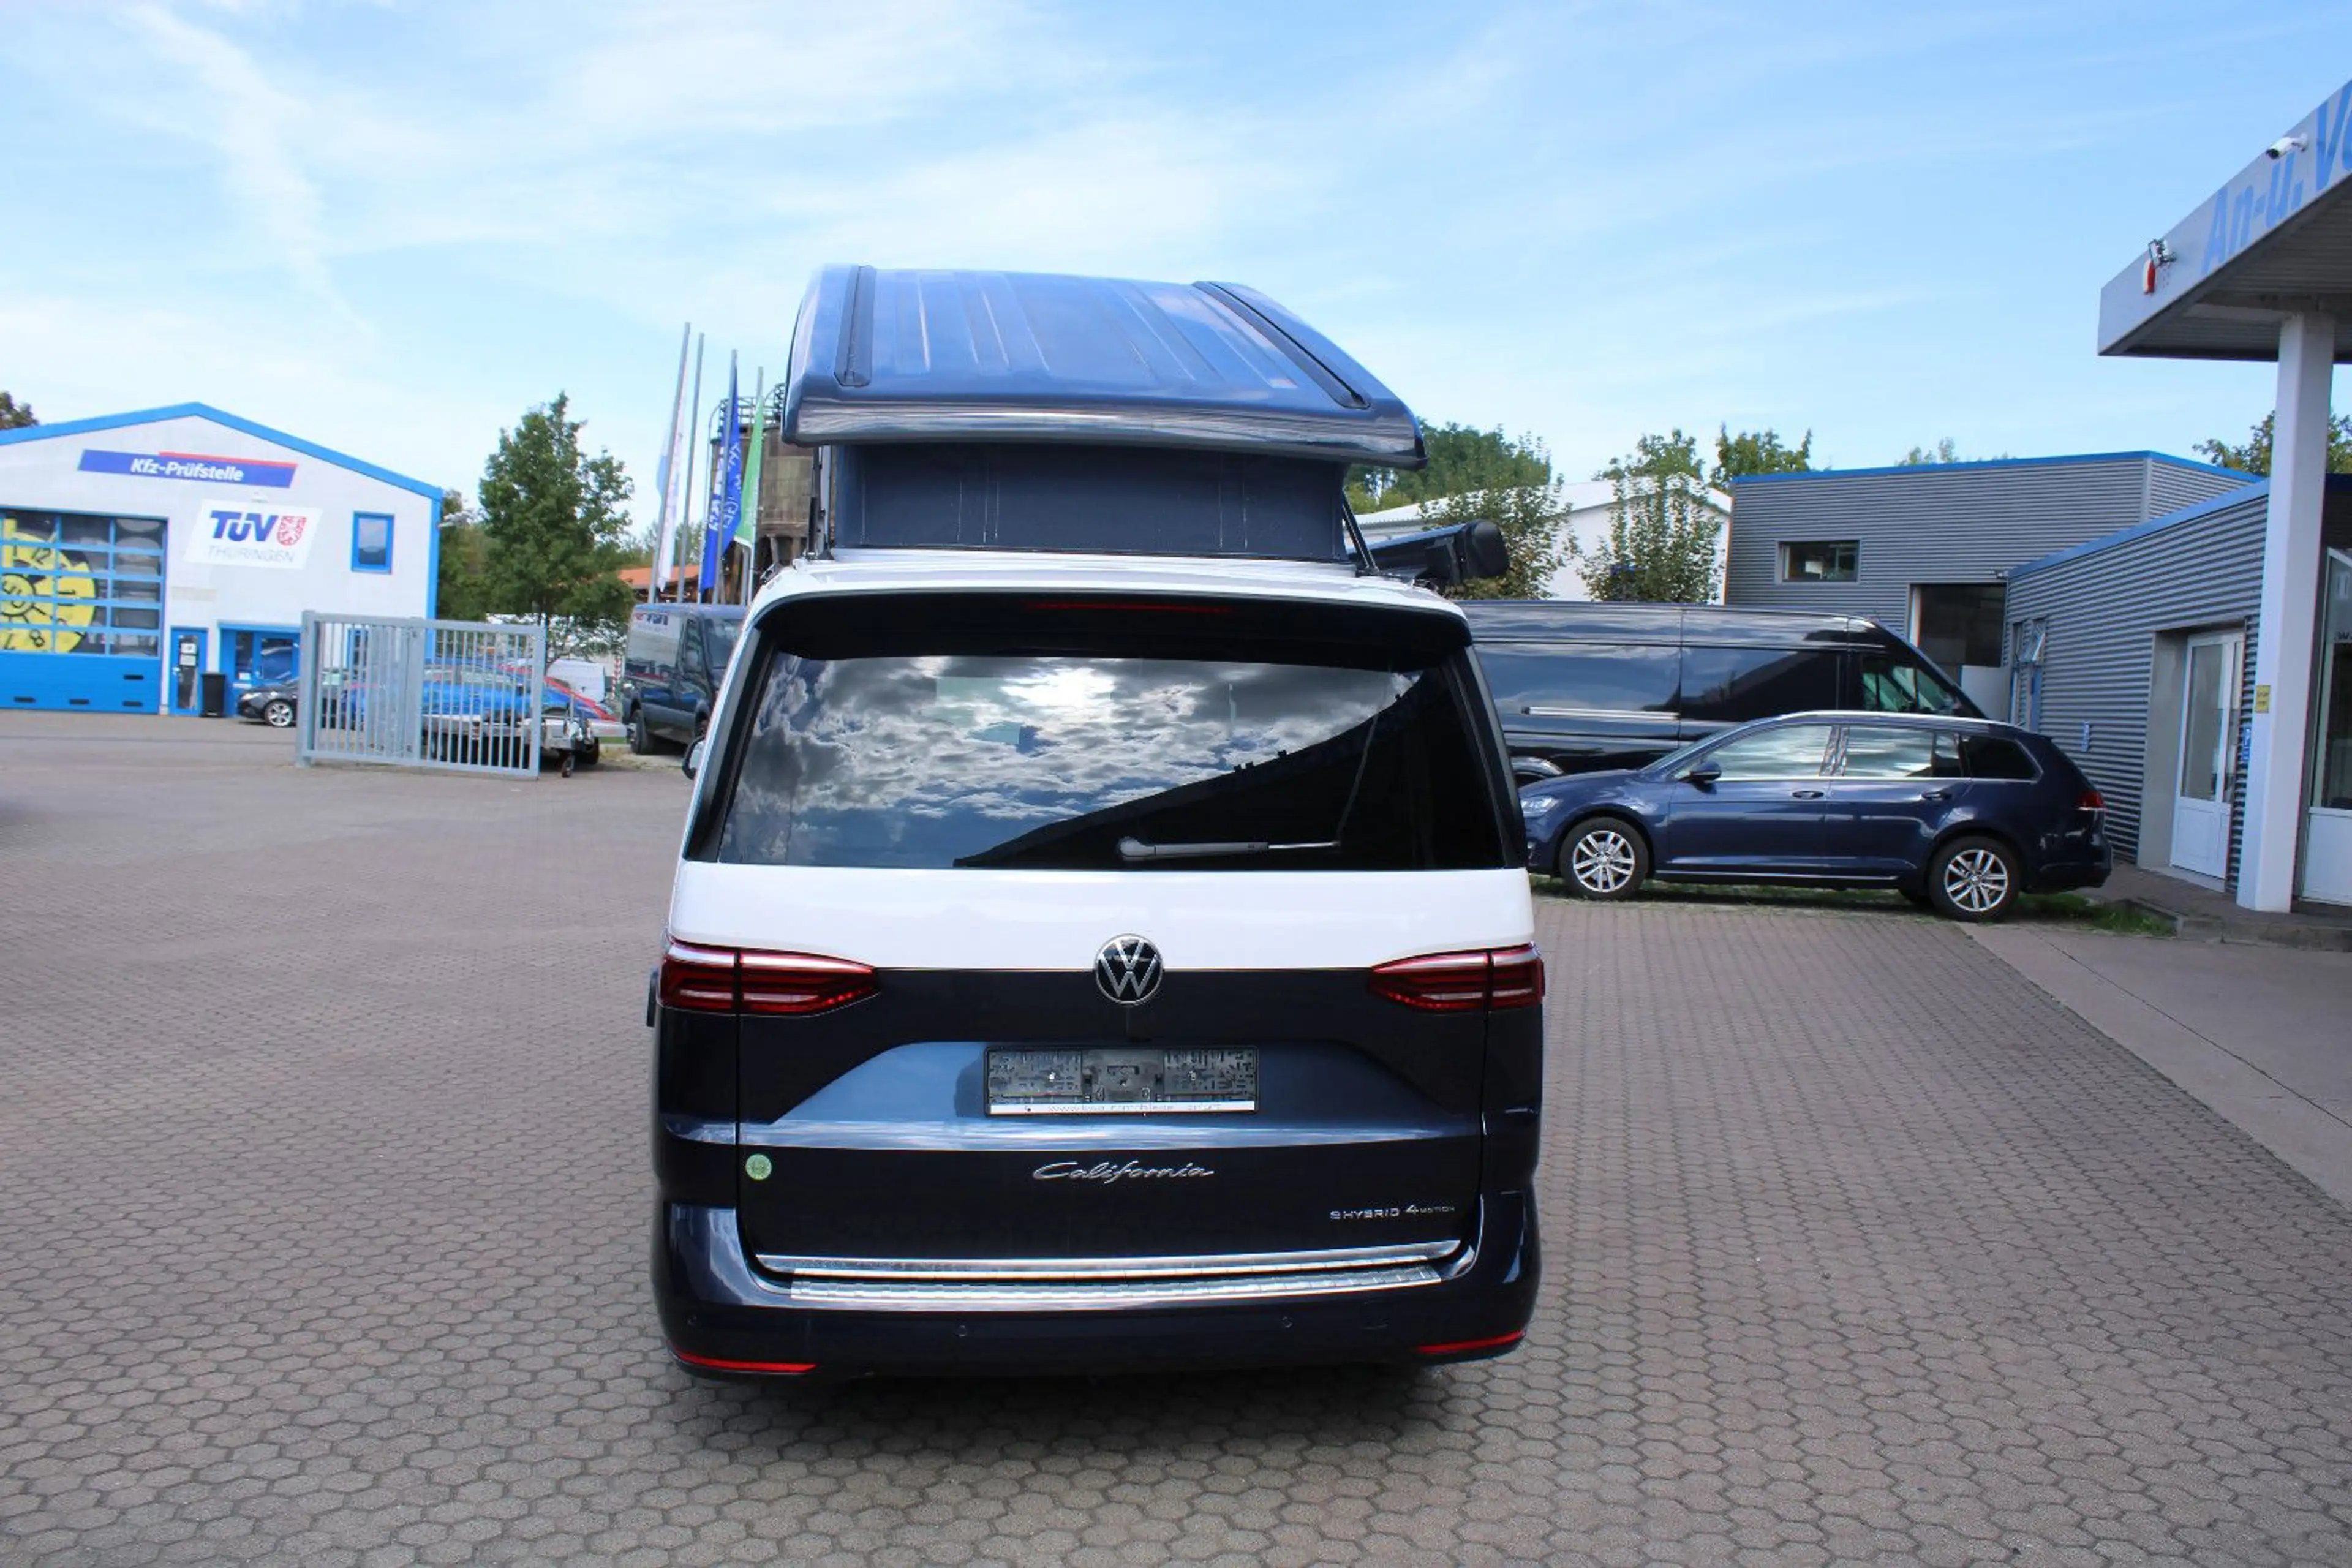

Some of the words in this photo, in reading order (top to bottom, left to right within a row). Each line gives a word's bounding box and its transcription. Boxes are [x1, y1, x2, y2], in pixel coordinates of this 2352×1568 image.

[130, 458, 244, 481] Kfz-Prüfstelle
[210, 510, 279, 542] TÜV
[1032, 1159, 1215, 1184] California
